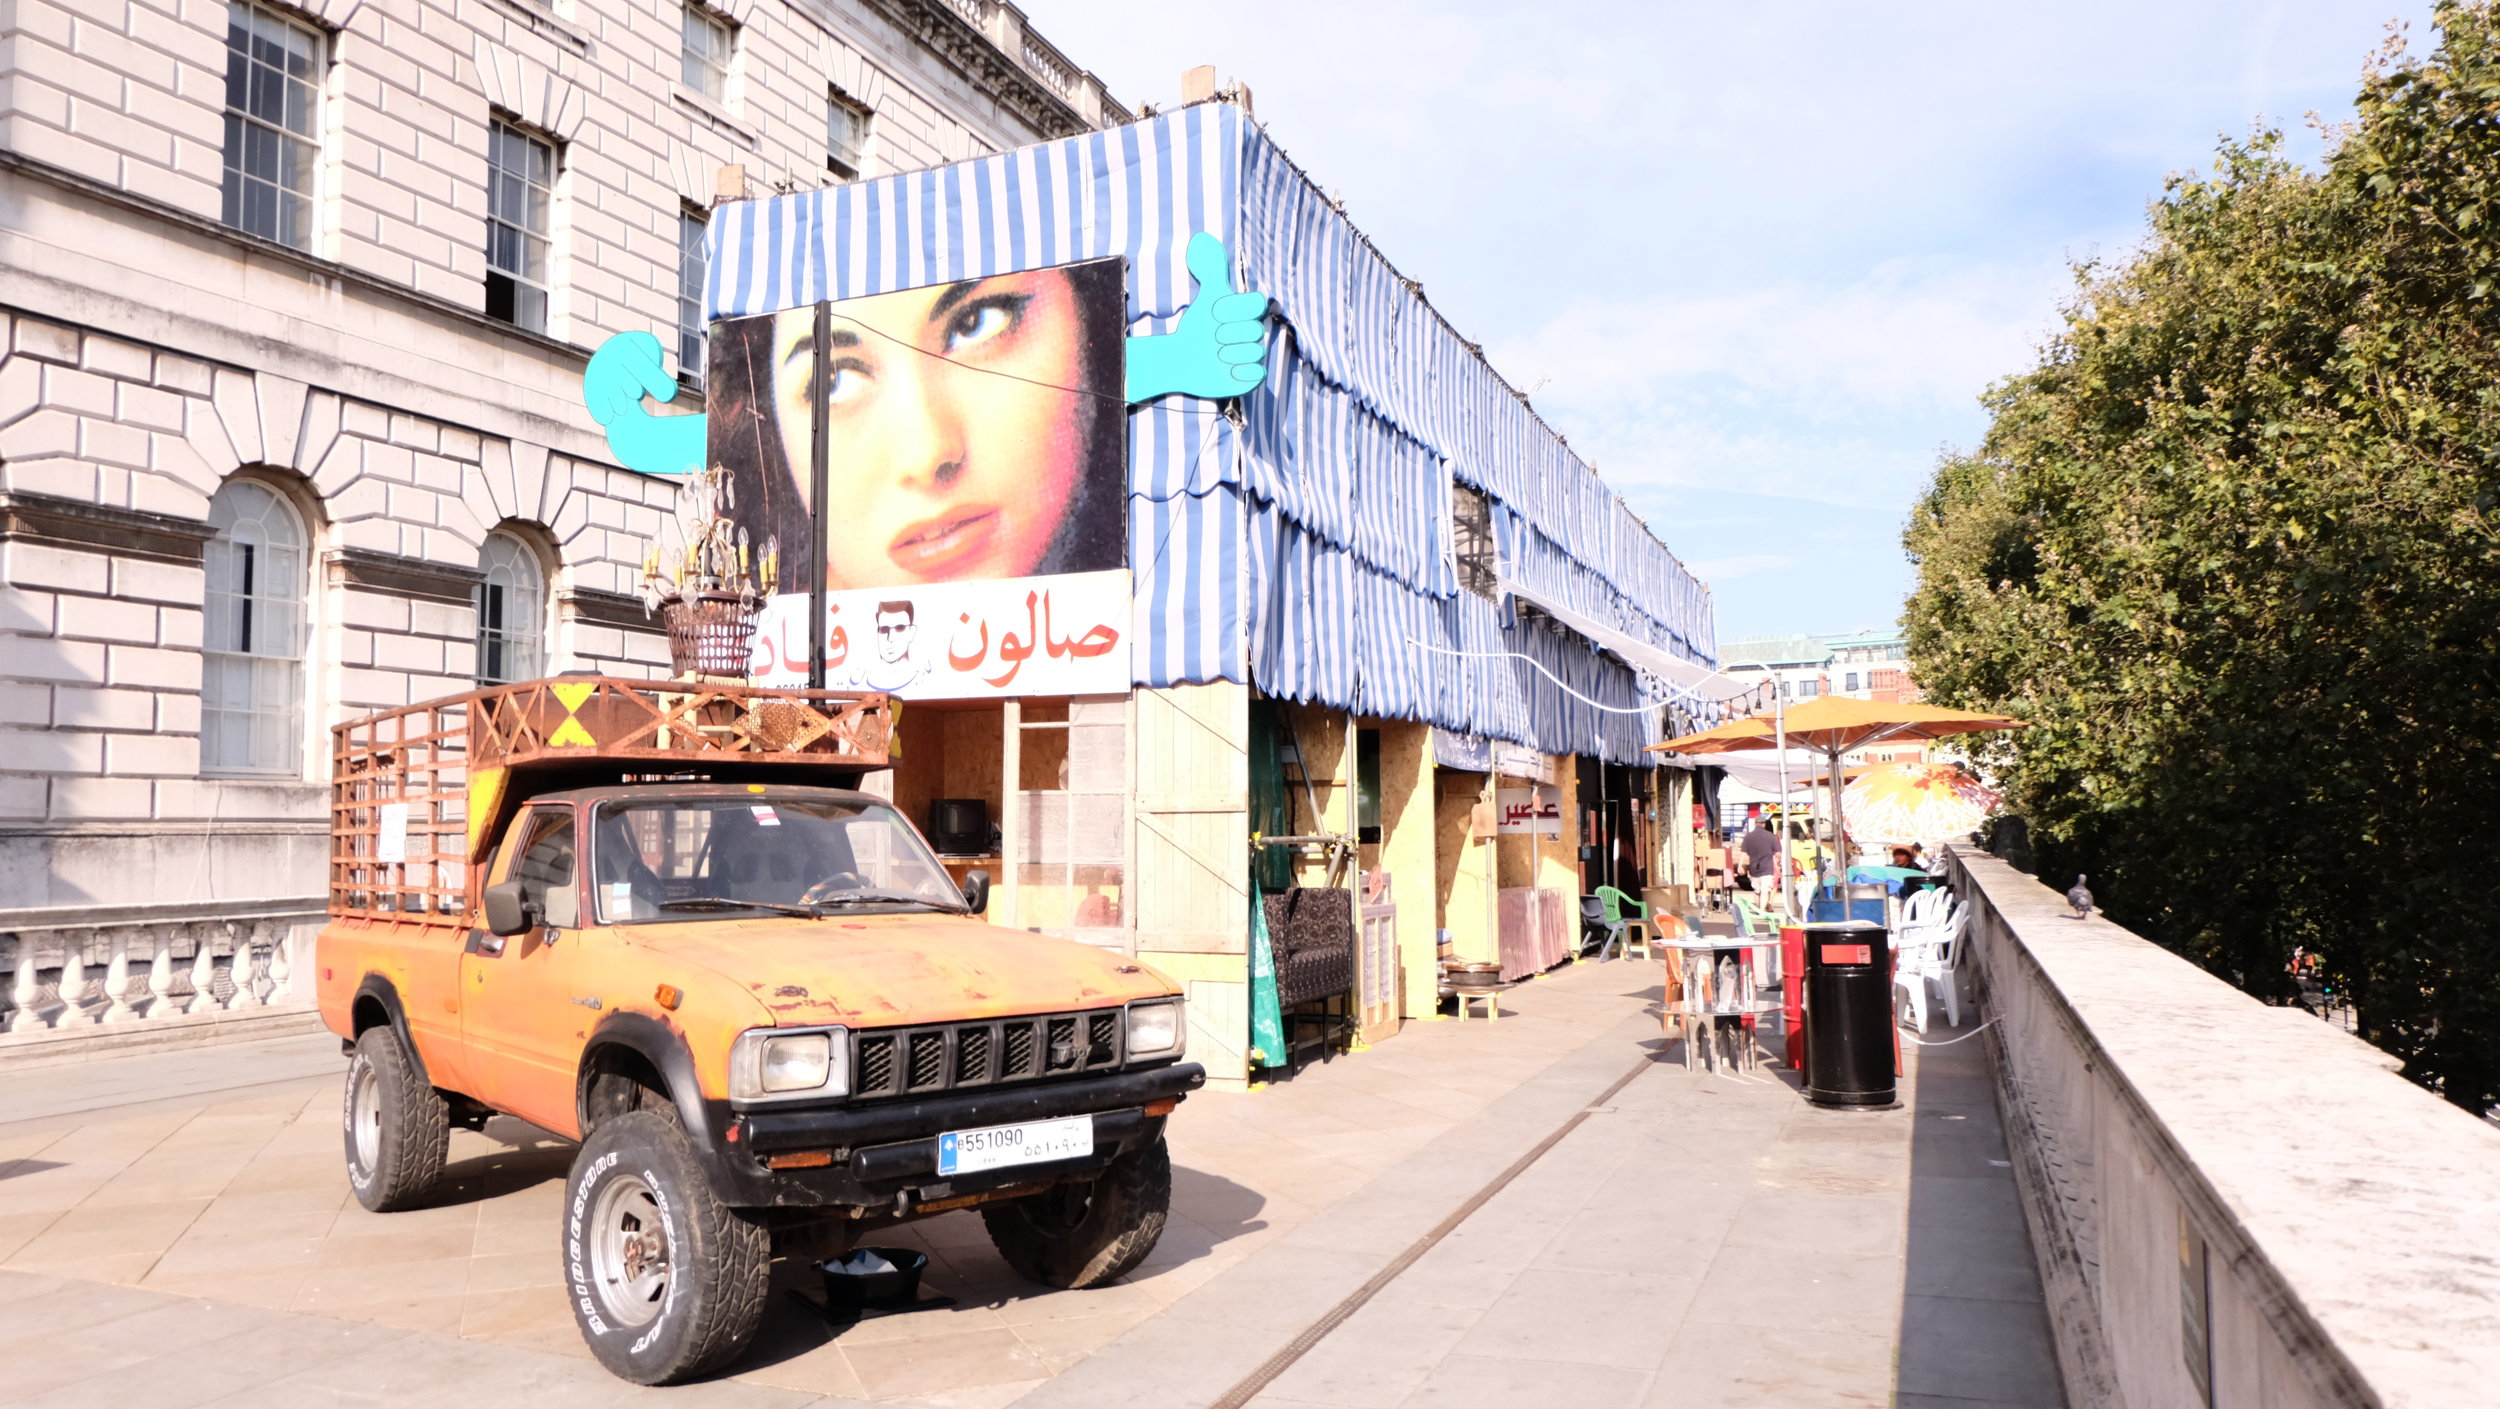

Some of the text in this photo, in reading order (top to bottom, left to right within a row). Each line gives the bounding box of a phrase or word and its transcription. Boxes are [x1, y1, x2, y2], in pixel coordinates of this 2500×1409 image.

[948, 588, 1121, 689] صالون
[1498, 801, 1560, 826] عصير
[569, 1151, 617, 1336] BRIDGESTONE
